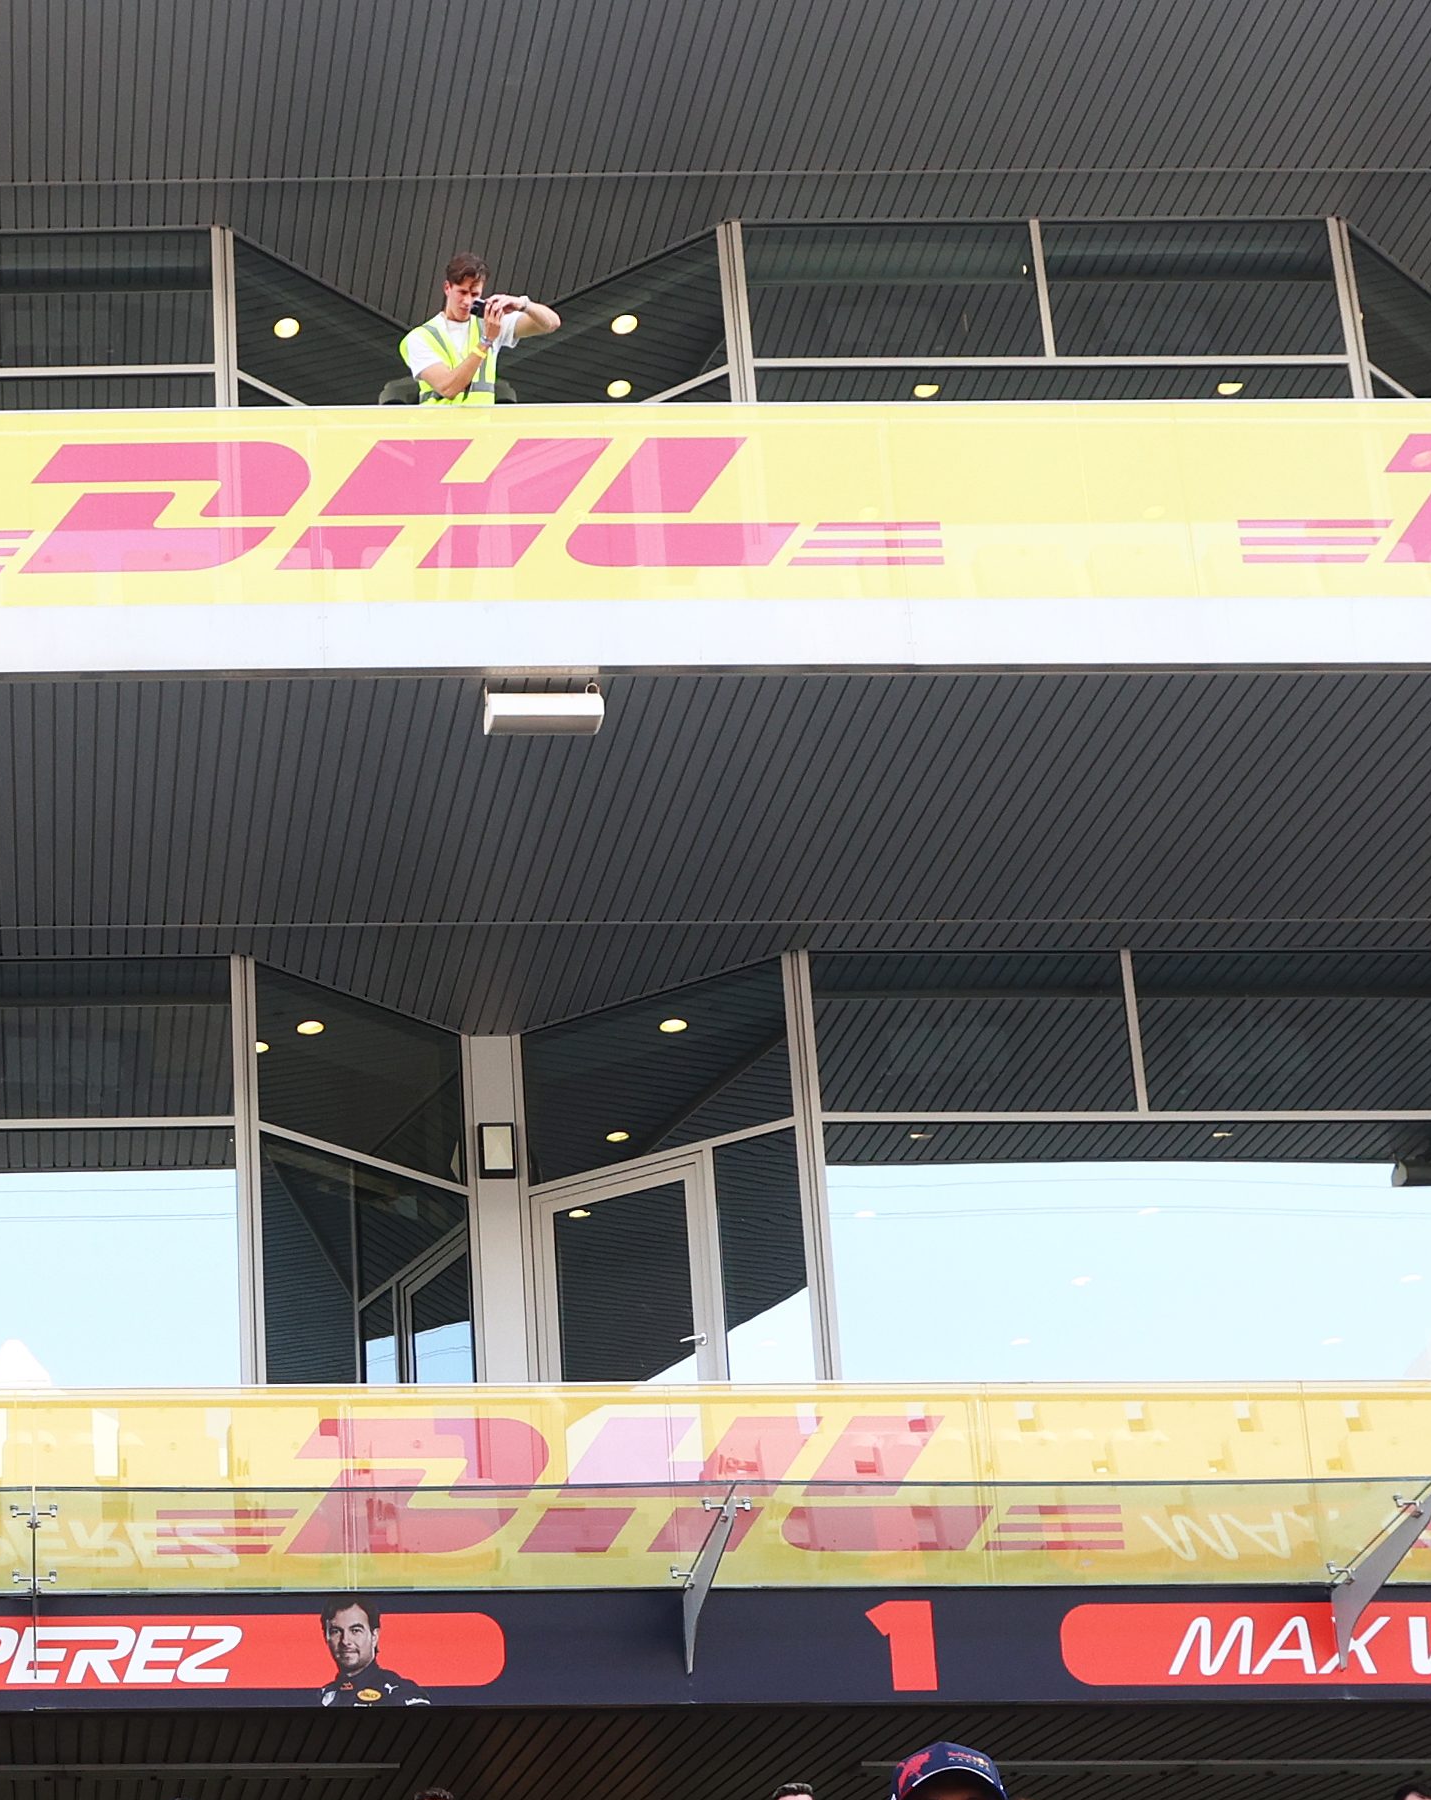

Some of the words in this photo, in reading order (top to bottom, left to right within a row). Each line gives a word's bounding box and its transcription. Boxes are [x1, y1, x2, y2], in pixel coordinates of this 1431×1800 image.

[18, 438, 800, 574] DHL
[284, 1414, 995, 1555] DHL
[866, 1601, 937, 1691] 1
[1169, 1616, 1390, 1675] MAX
